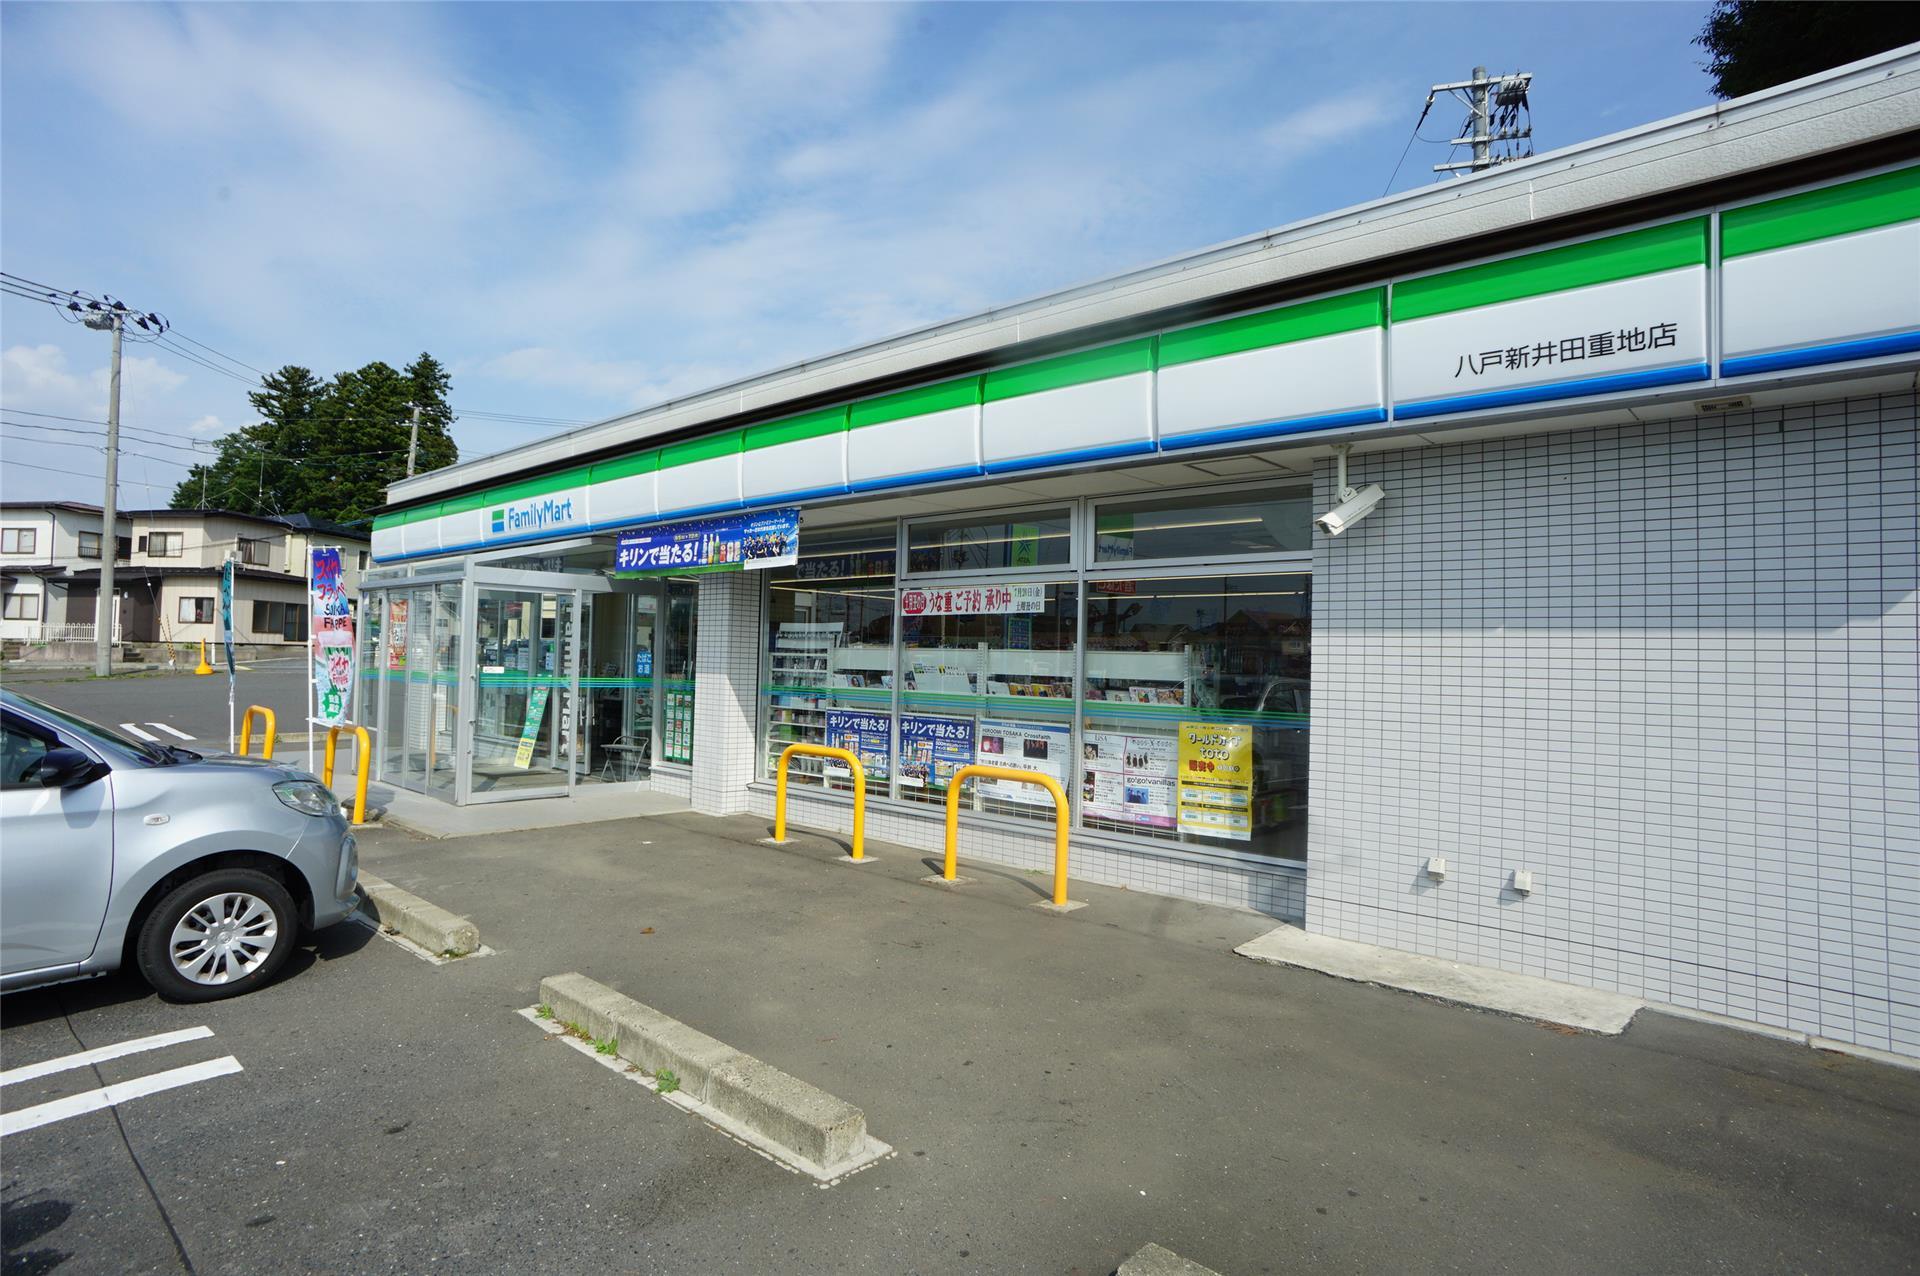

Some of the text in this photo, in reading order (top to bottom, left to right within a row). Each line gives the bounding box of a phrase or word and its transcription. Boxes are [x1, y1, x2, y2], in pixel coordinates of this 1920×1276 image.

[1454, 322, 1678, 378] 八戸新井田重地店
[508, 498, 572, 530] FamilyMart
[929, 587, 1012, 613] うな重 ご予約 承り中
[1002, 729, 1022, 737] TOSAKA
[1126, 776, 1176, 787] go!go!vanillas
